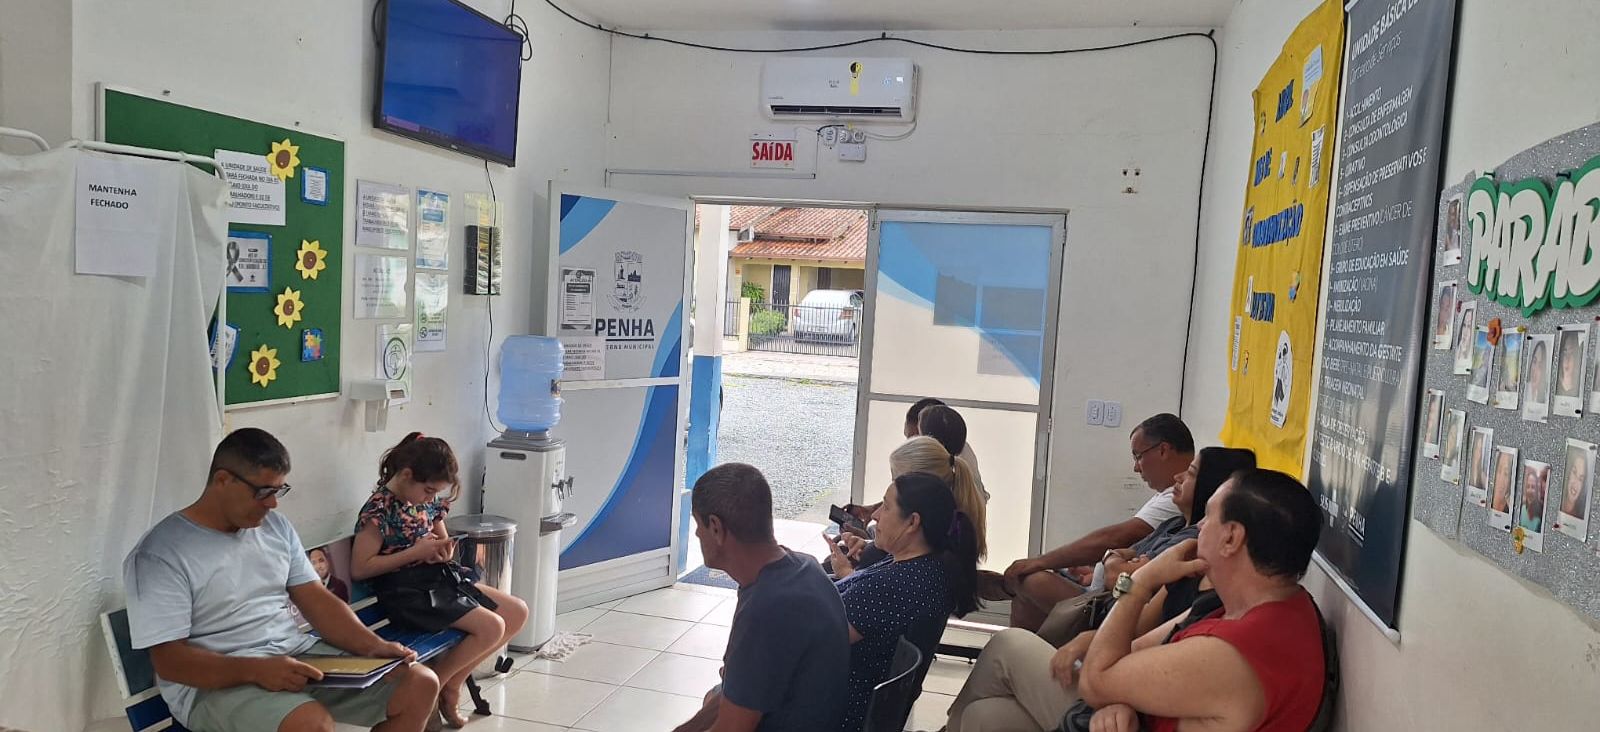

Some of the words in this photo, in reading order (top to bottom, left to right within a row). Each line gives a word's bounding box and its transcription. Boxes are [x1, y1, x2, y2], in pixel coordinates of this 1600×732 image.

[1351, 19, 1380, 61] UNIDADE
[1380, 0, 1407, 35] BÁSICA
[1348, 115, 1370, 138] CONSULTA
[1371, 111, 1377, 125] DE
[1377, 85, 1413, 121] ENFERMAGEM
[1350, 87, 1382, 119] ACOLHIMENTO
[1347, 137, 1368, 158] CONSULTA
[1368, 111, 1408, 146] ODONTOLÓGICA
[1345, 156, 1366, 177] CURATIVO
[1372, 170, 1379, 184] DE
[1379, 149, 1423, 180] PRESERVATIVOS
[1423, 146, 1428, 163] E
[88, 184, 137, 196] MANTENHA
[90, 198, 129, 210] FECHADO
[1336, 192, 1373, 218] CONTRACEPTIVOS
[1338, 221, 1351, 236] EXAME
[1351, 210, 1380, 232] PREVENTIVO
[1402, 200, 1413, 218] DE
[1335, 260, 1349, 273] GRUPO
[1349, 258, 1355, 272] DE
[1355, 252, 1380, 273] EDUCAÇÃO
[1380, 252, 1388, 267] EM
[1389, 246, 1409, 266] SAÚDE
[1334, 296, 1361, 316] NEBULIZAÇÃO
[595, 318, 655, 337] PENHA
[1330, 318, 1362, 334] PLANEJAMENTO
[1362, 319, 1386, 336] FAMILIAR
[1329, 338, 1369, 356] ACOMPANHAMENTO
[1369, 343, 1377, 358] DA
[1377, 344, 1402, 362] GESTANTE
[1324, 376, 1341, 391] TRIAGEM
[1341, 381, 1365, 400] NEONATAL
[1320, 414, 1330, 428] SALA
[1330, 417, 1336, 432] DE
[1336, 420, 1366, 446] OBSERVAÇÃO
[1349, 505, 1366, 536] PENHA
